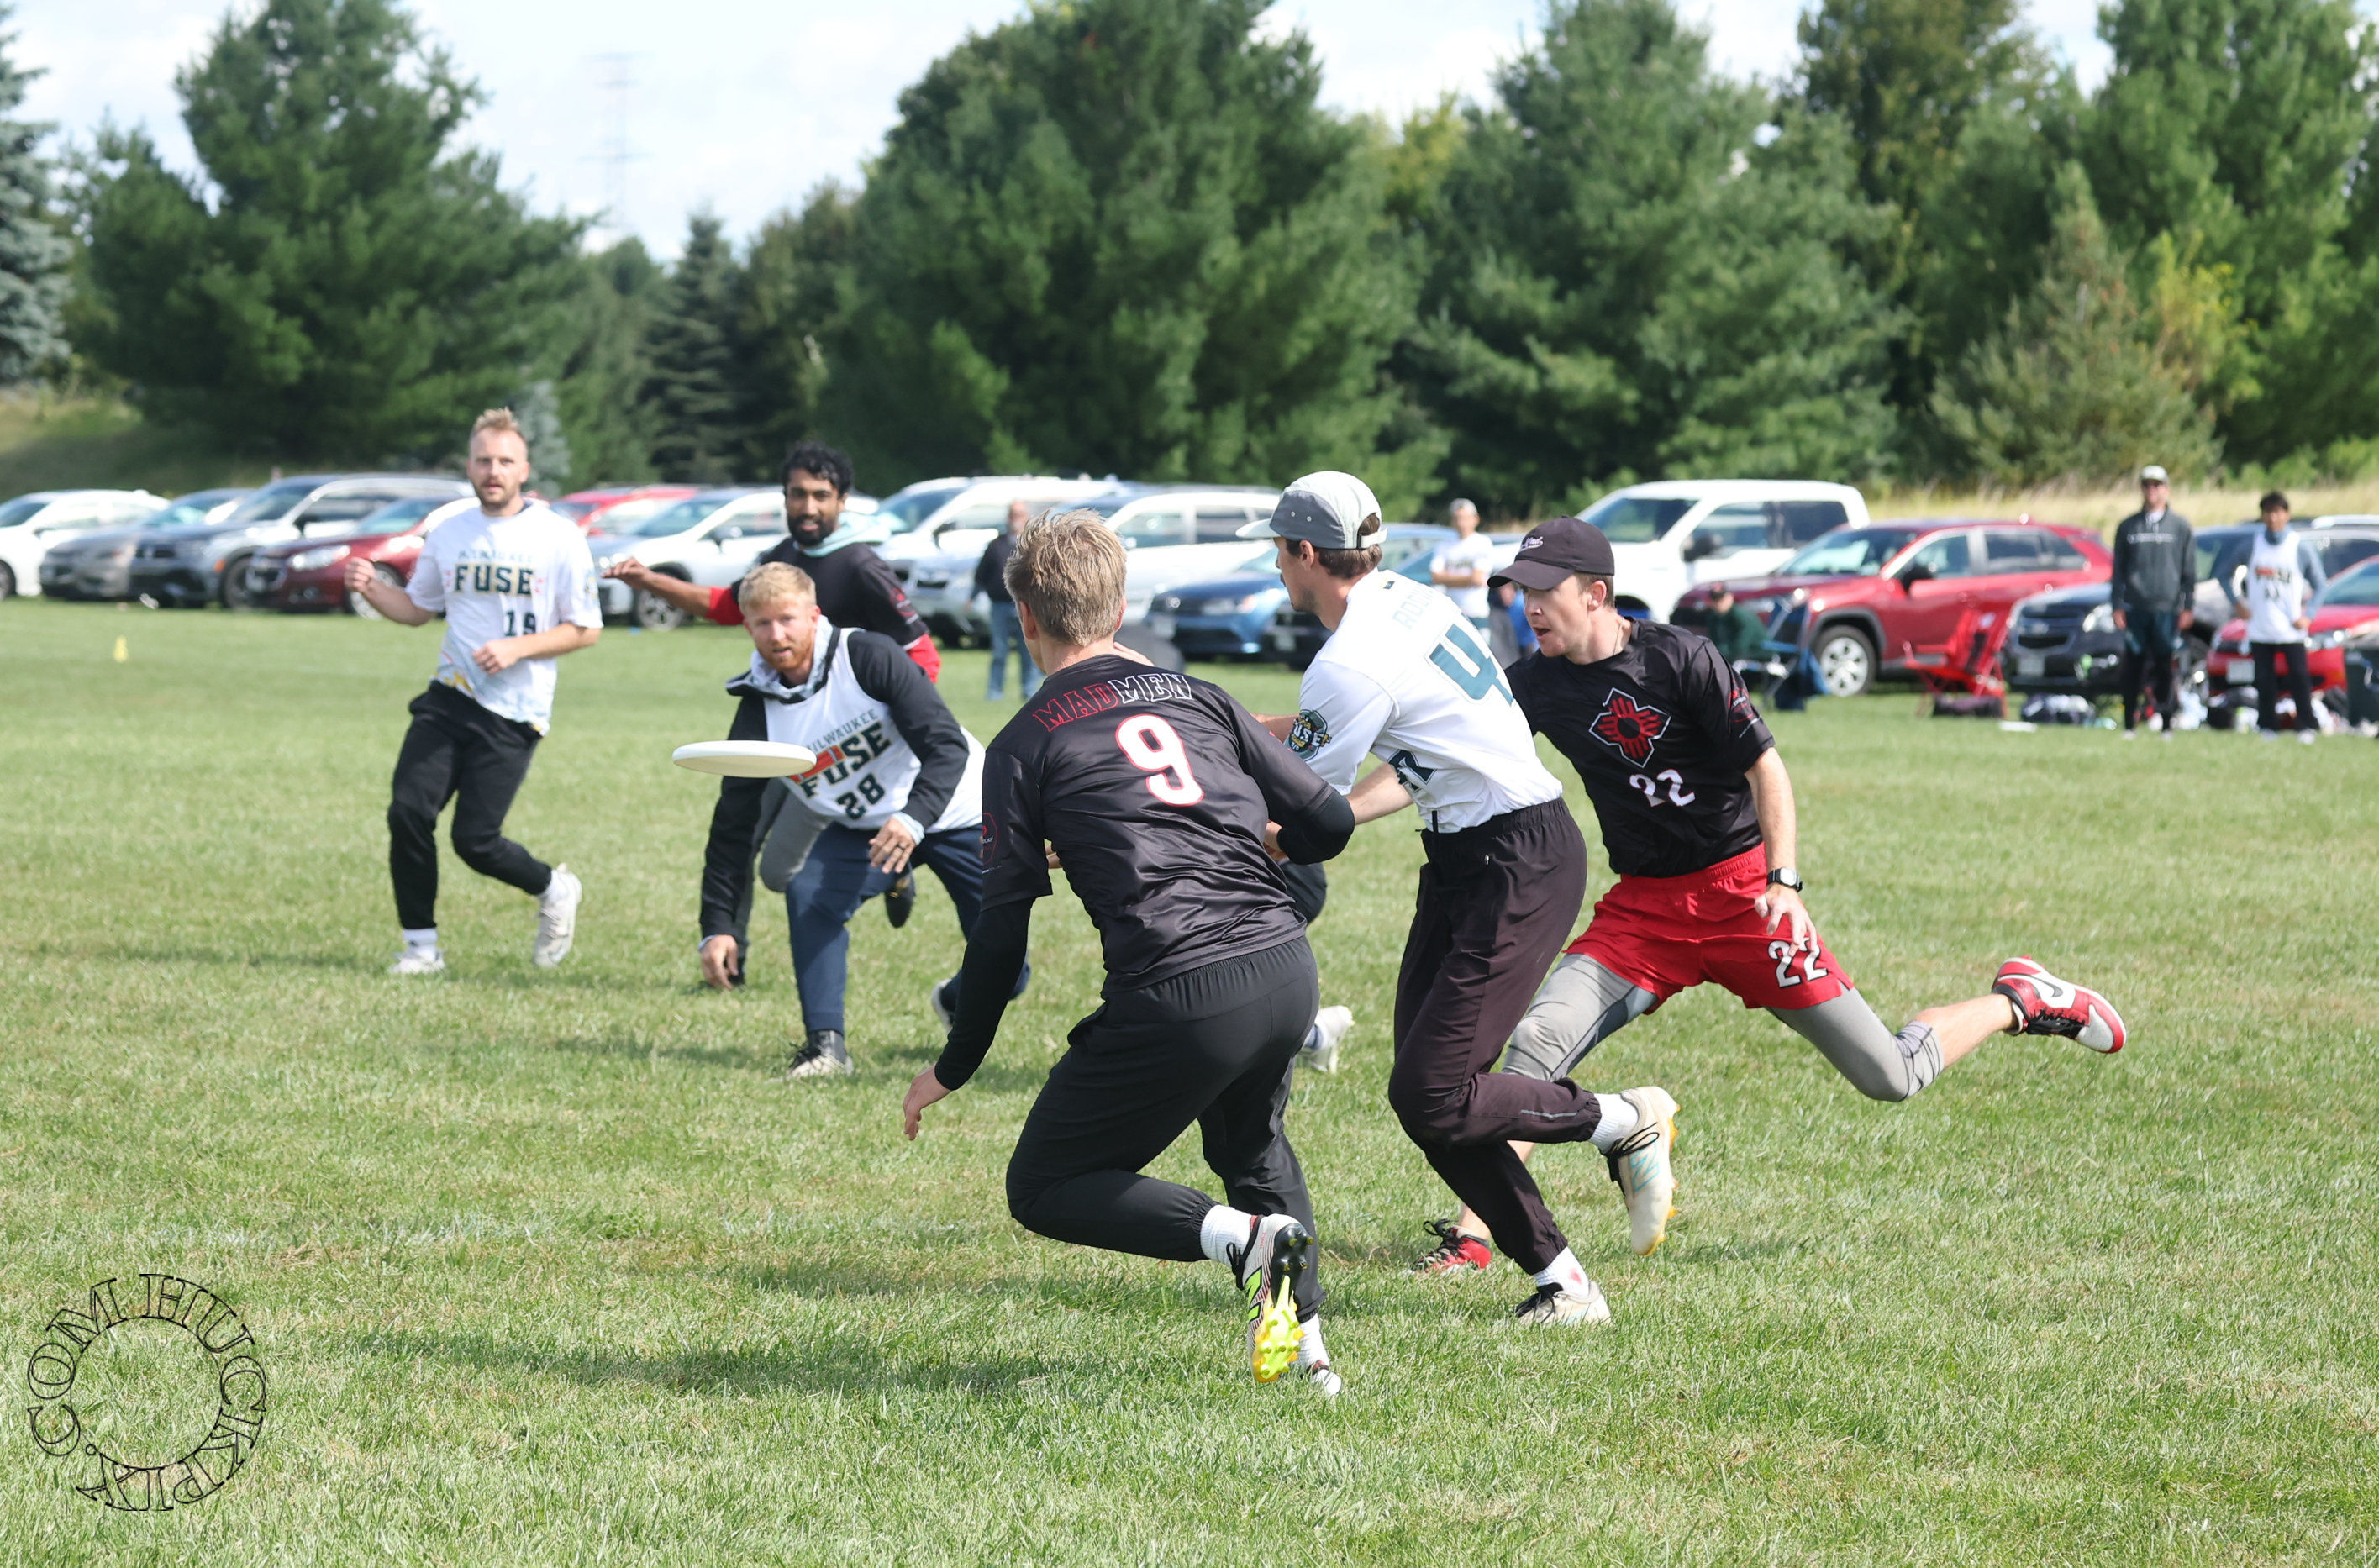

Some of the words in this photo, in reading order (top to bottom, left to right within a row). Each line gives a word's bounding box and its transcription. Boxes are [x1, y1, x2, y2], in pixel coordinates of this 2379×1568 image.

[453, 563, 534, 596] FUSE
[505, 610, 536, 636] 19
[1033, 673, 1193, 732] MADMEN
[799, 720, 892, 797] FUSE
[1115, 713, 1205, 807] 9
[836, 772, 885, 821] 28
[1629, 768, 1696, 807] 22
[1767, 937, 1829, 988] 22
